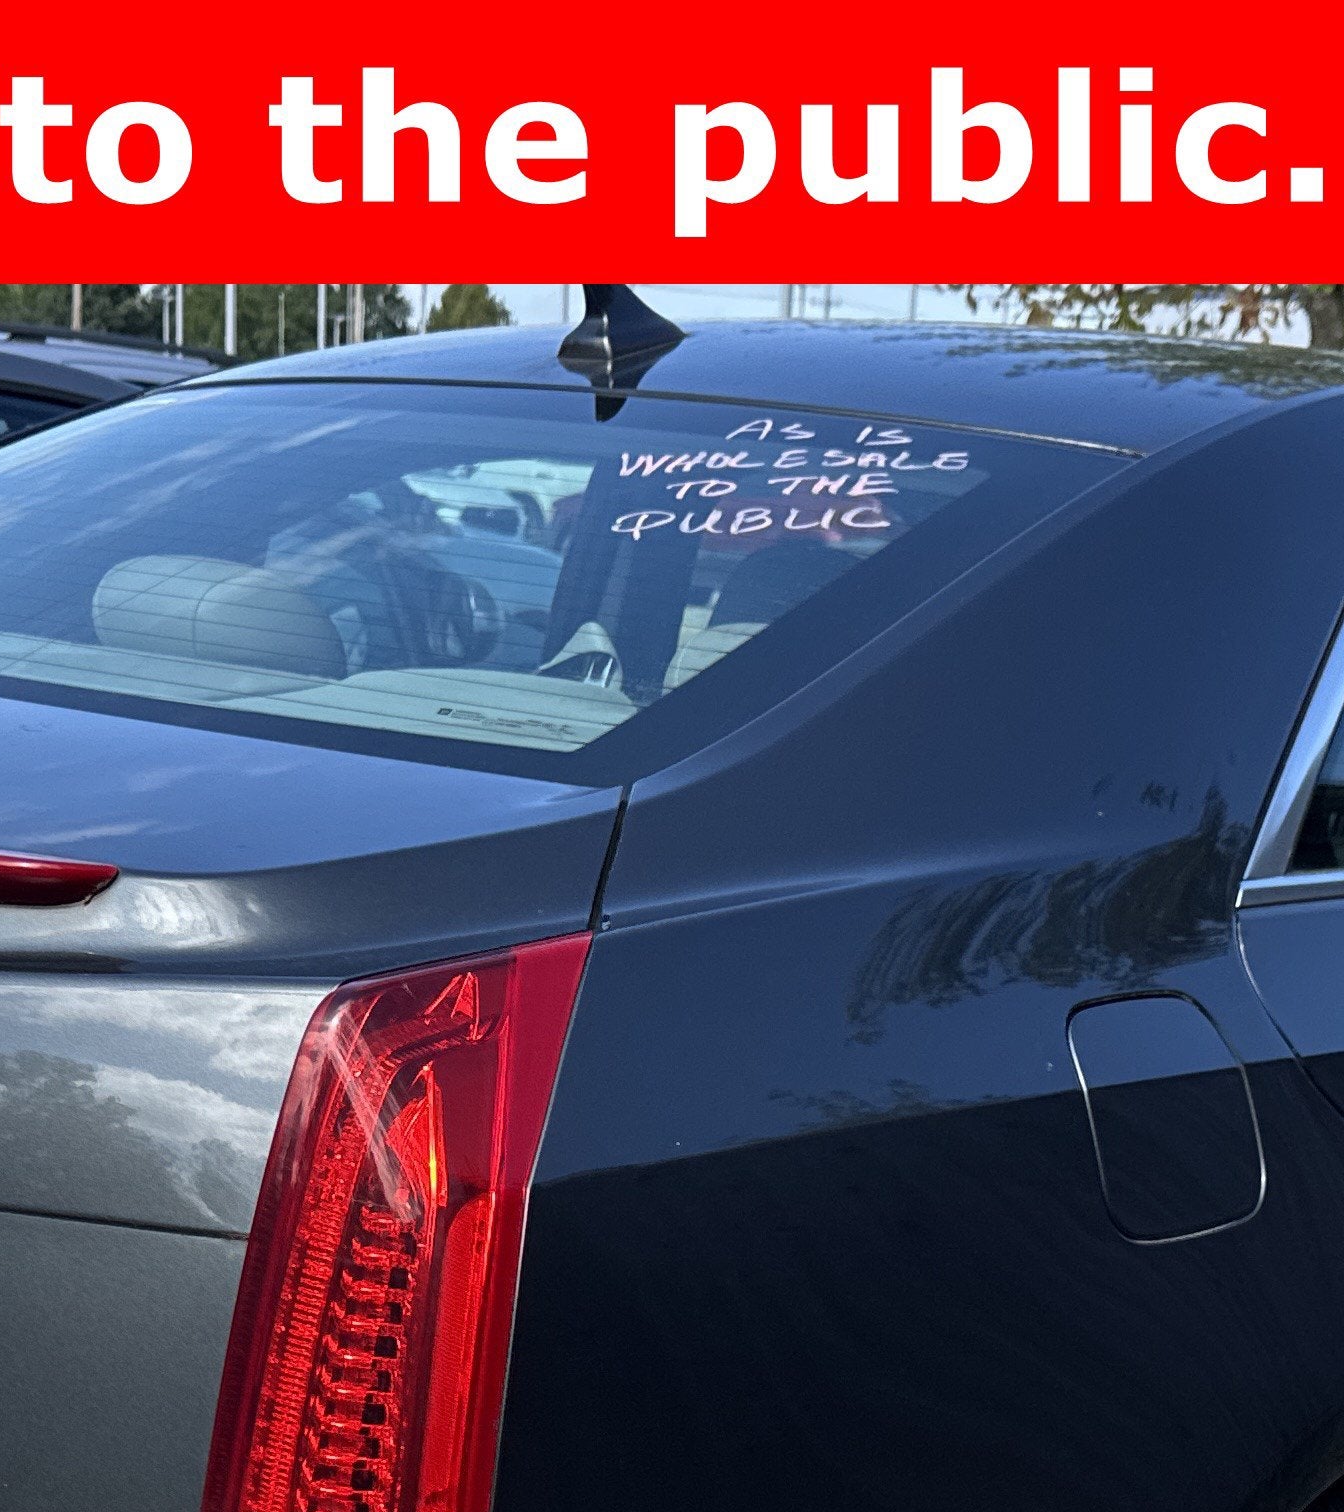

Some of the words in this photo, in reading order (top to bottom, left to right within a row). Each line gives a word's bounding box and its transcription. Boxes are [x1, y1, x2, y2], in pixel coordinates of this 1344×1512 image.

[725, 419, 815, 440] AS
[856, 426, 913, 446] IS
[619, 449, 969, 477] WHOLESALE
[666, 479, 737, 499] TO
[768, 472, 899, 496] THE
[611, 507, 891, 540] PUBLIC
